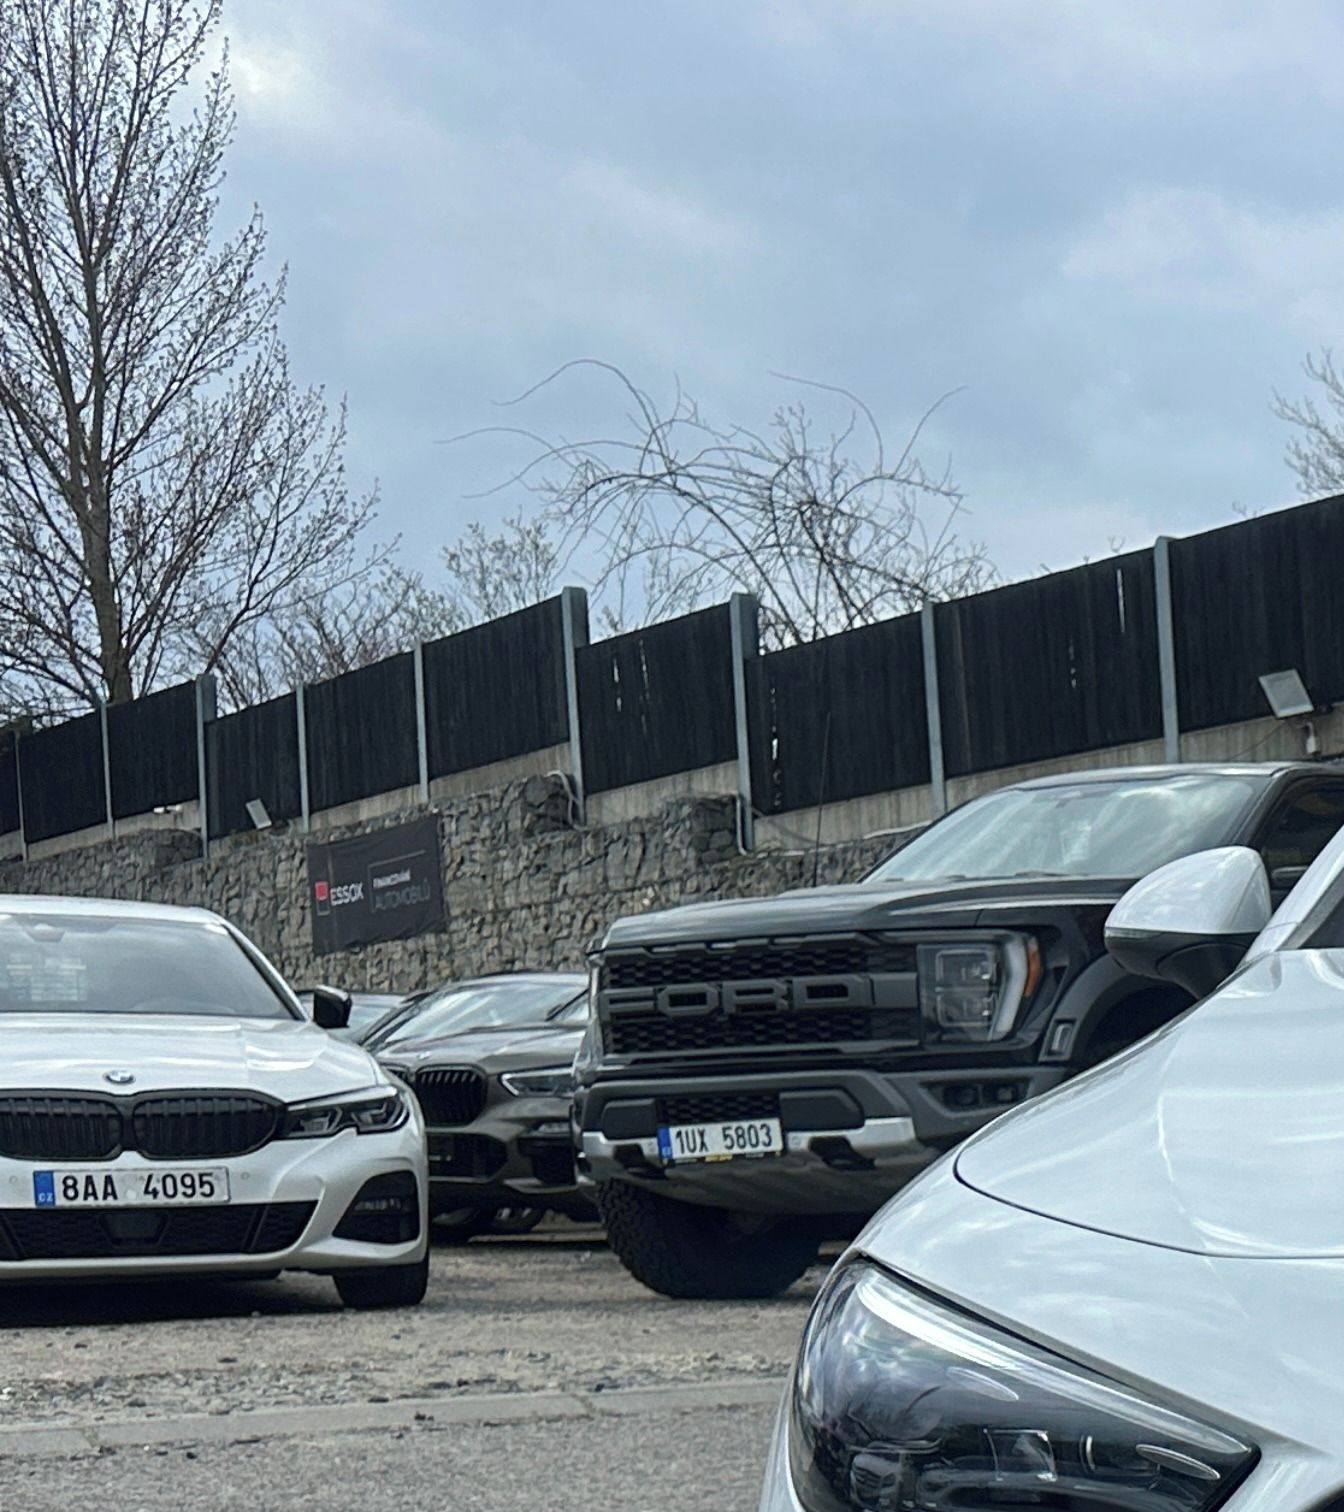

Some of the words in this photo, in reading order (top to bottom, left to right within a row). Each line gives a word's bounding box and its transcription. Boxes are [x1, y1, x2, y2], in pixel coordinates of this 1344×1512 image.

[330, 881, 364, 906] ESSOX
[600, 974, 874, 1022] FORD
[675, 1129, 709, 1154] 1UX
[721, 1123, 773, 1150] 5803
[62, 1174, 118, 1201] 8AA
[143, 1172, 215, 1200] 4095
